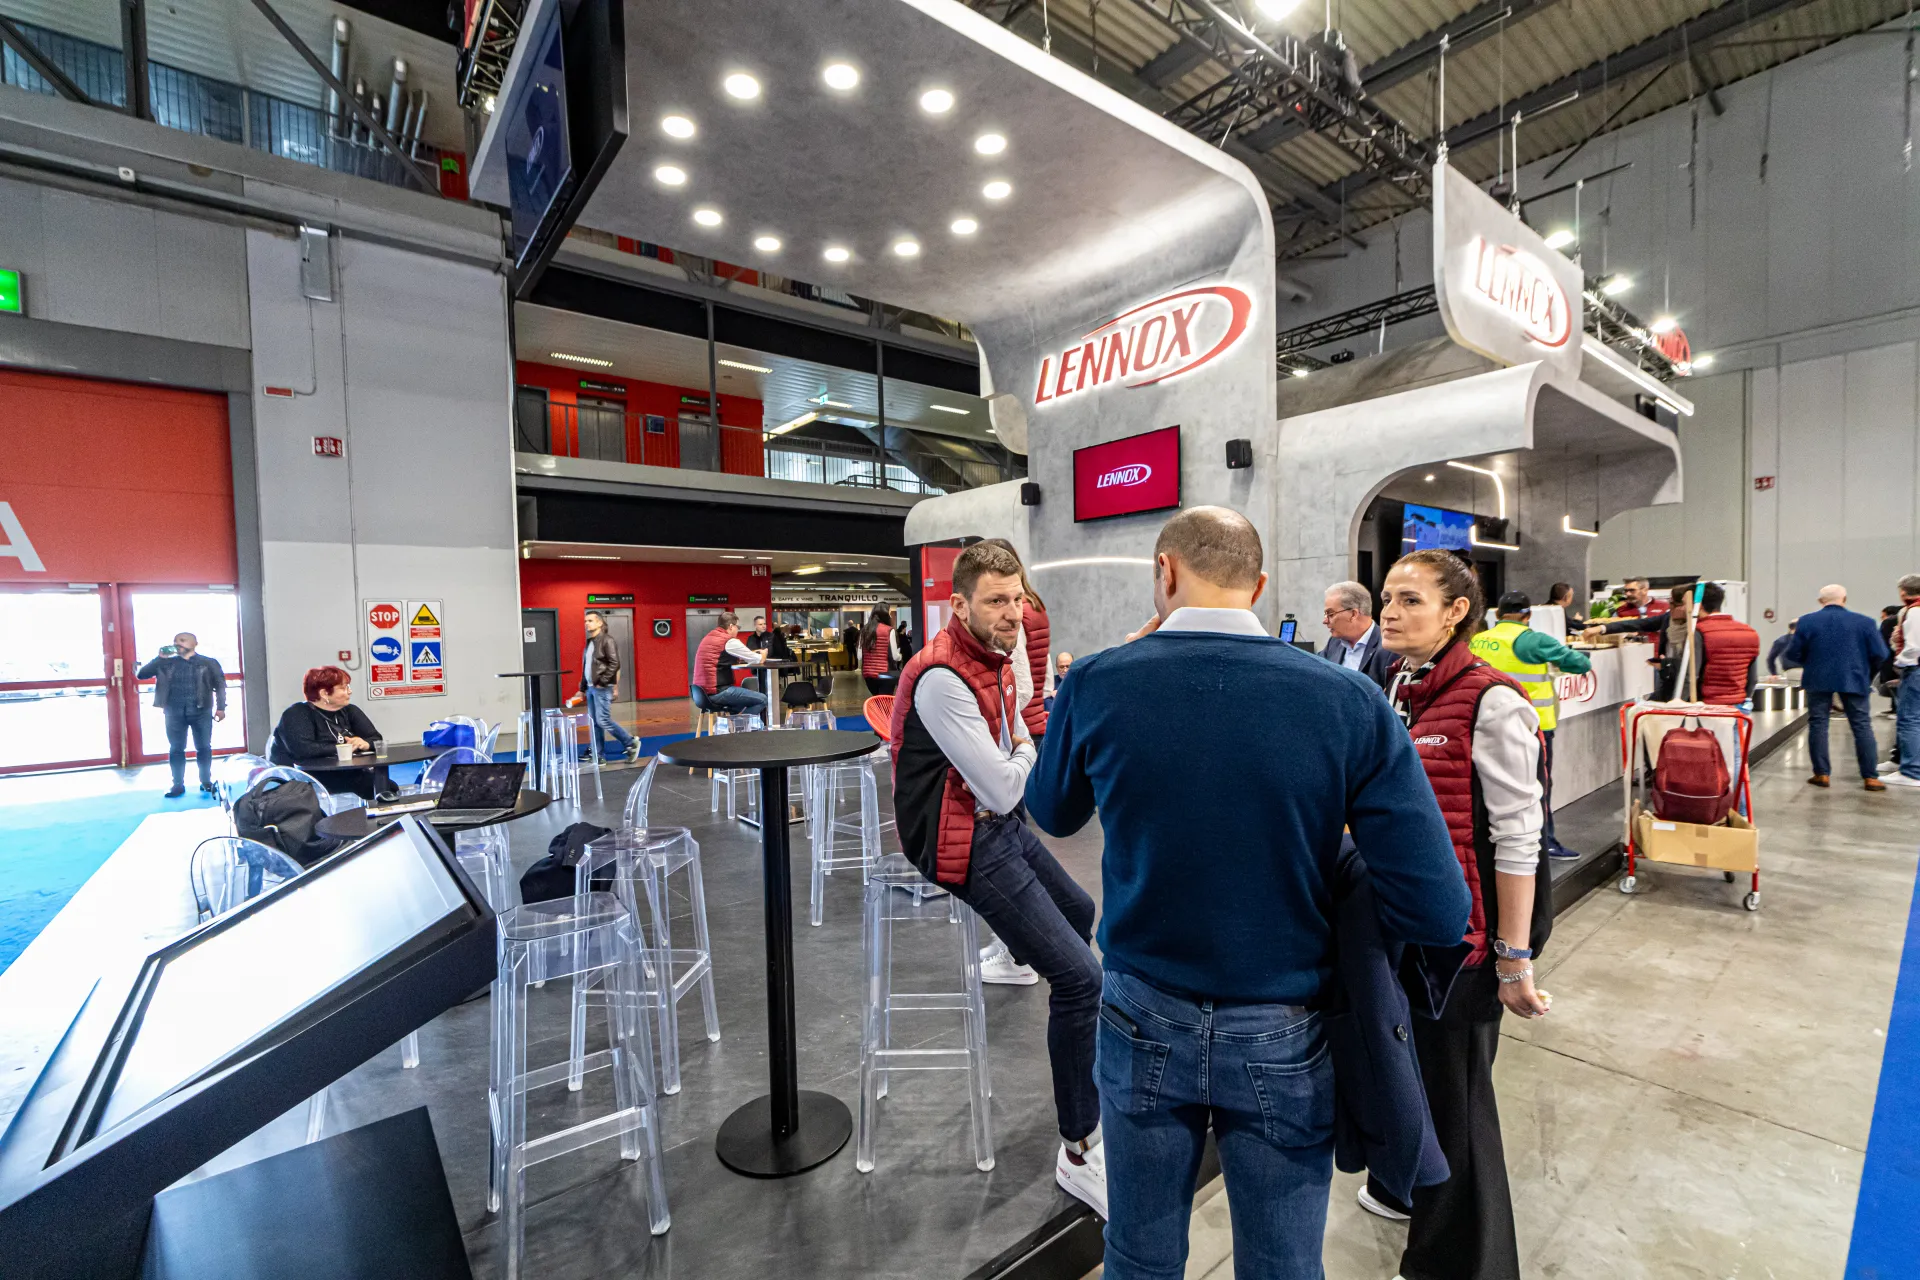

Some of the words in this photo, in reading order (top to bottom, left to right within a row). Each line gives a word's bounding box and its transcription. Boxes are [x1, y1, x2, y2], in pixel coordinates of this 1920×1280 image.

[1035, 301, 1202, 405] LENNOX
[1097, 466, 1142, 489] LENNOX
[819, 594, 878, 603] TRANQUILLO
[370, 611, 399, 622] STOP
[1414, 737, 1441, 745] LENNOX
